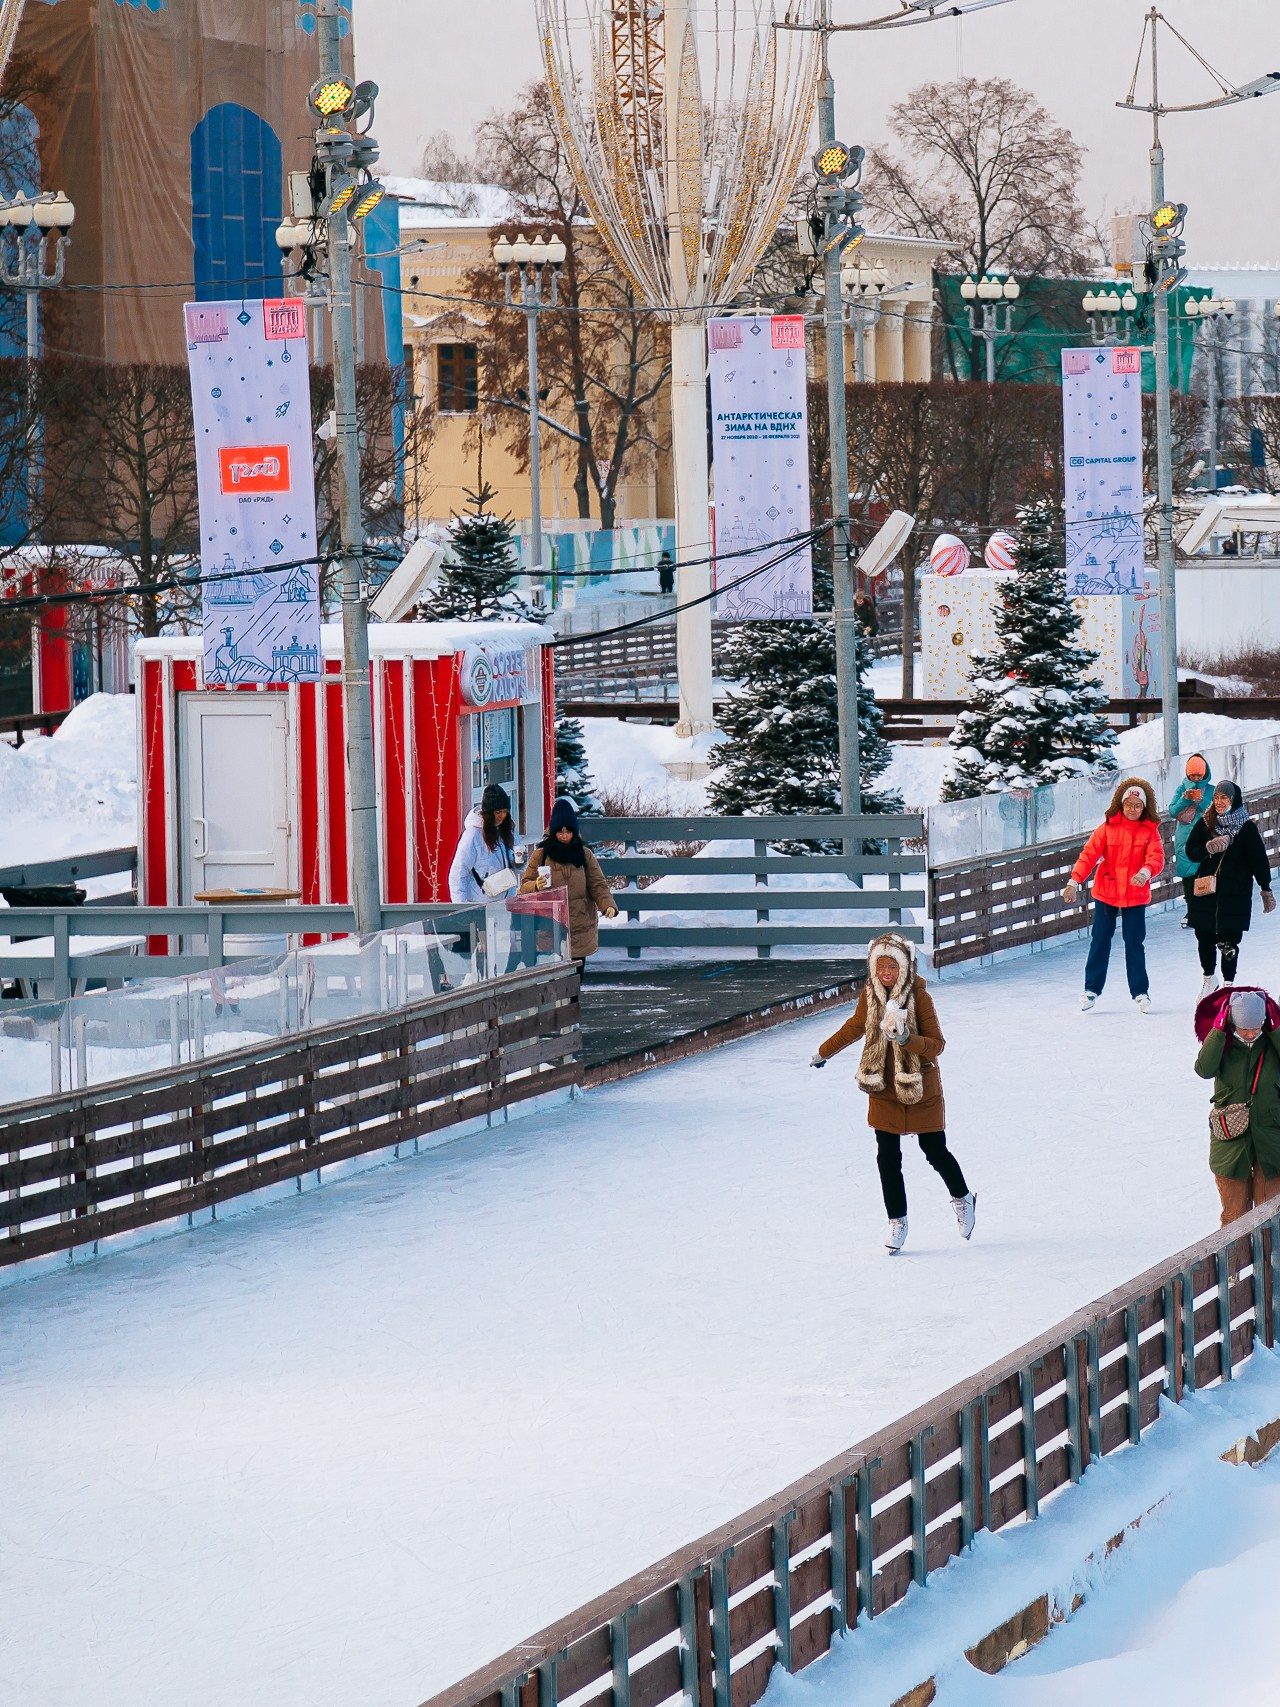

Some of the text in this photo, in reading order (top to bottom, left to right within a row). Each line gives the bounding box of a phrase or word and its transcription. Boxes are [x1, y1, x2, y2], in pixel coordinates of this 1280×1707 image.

[717, 412, 802, 421] АНТАРКТИЧЕСКАЯ
[724, 422, 796, 432] ЗИМА НА ВДНХ
